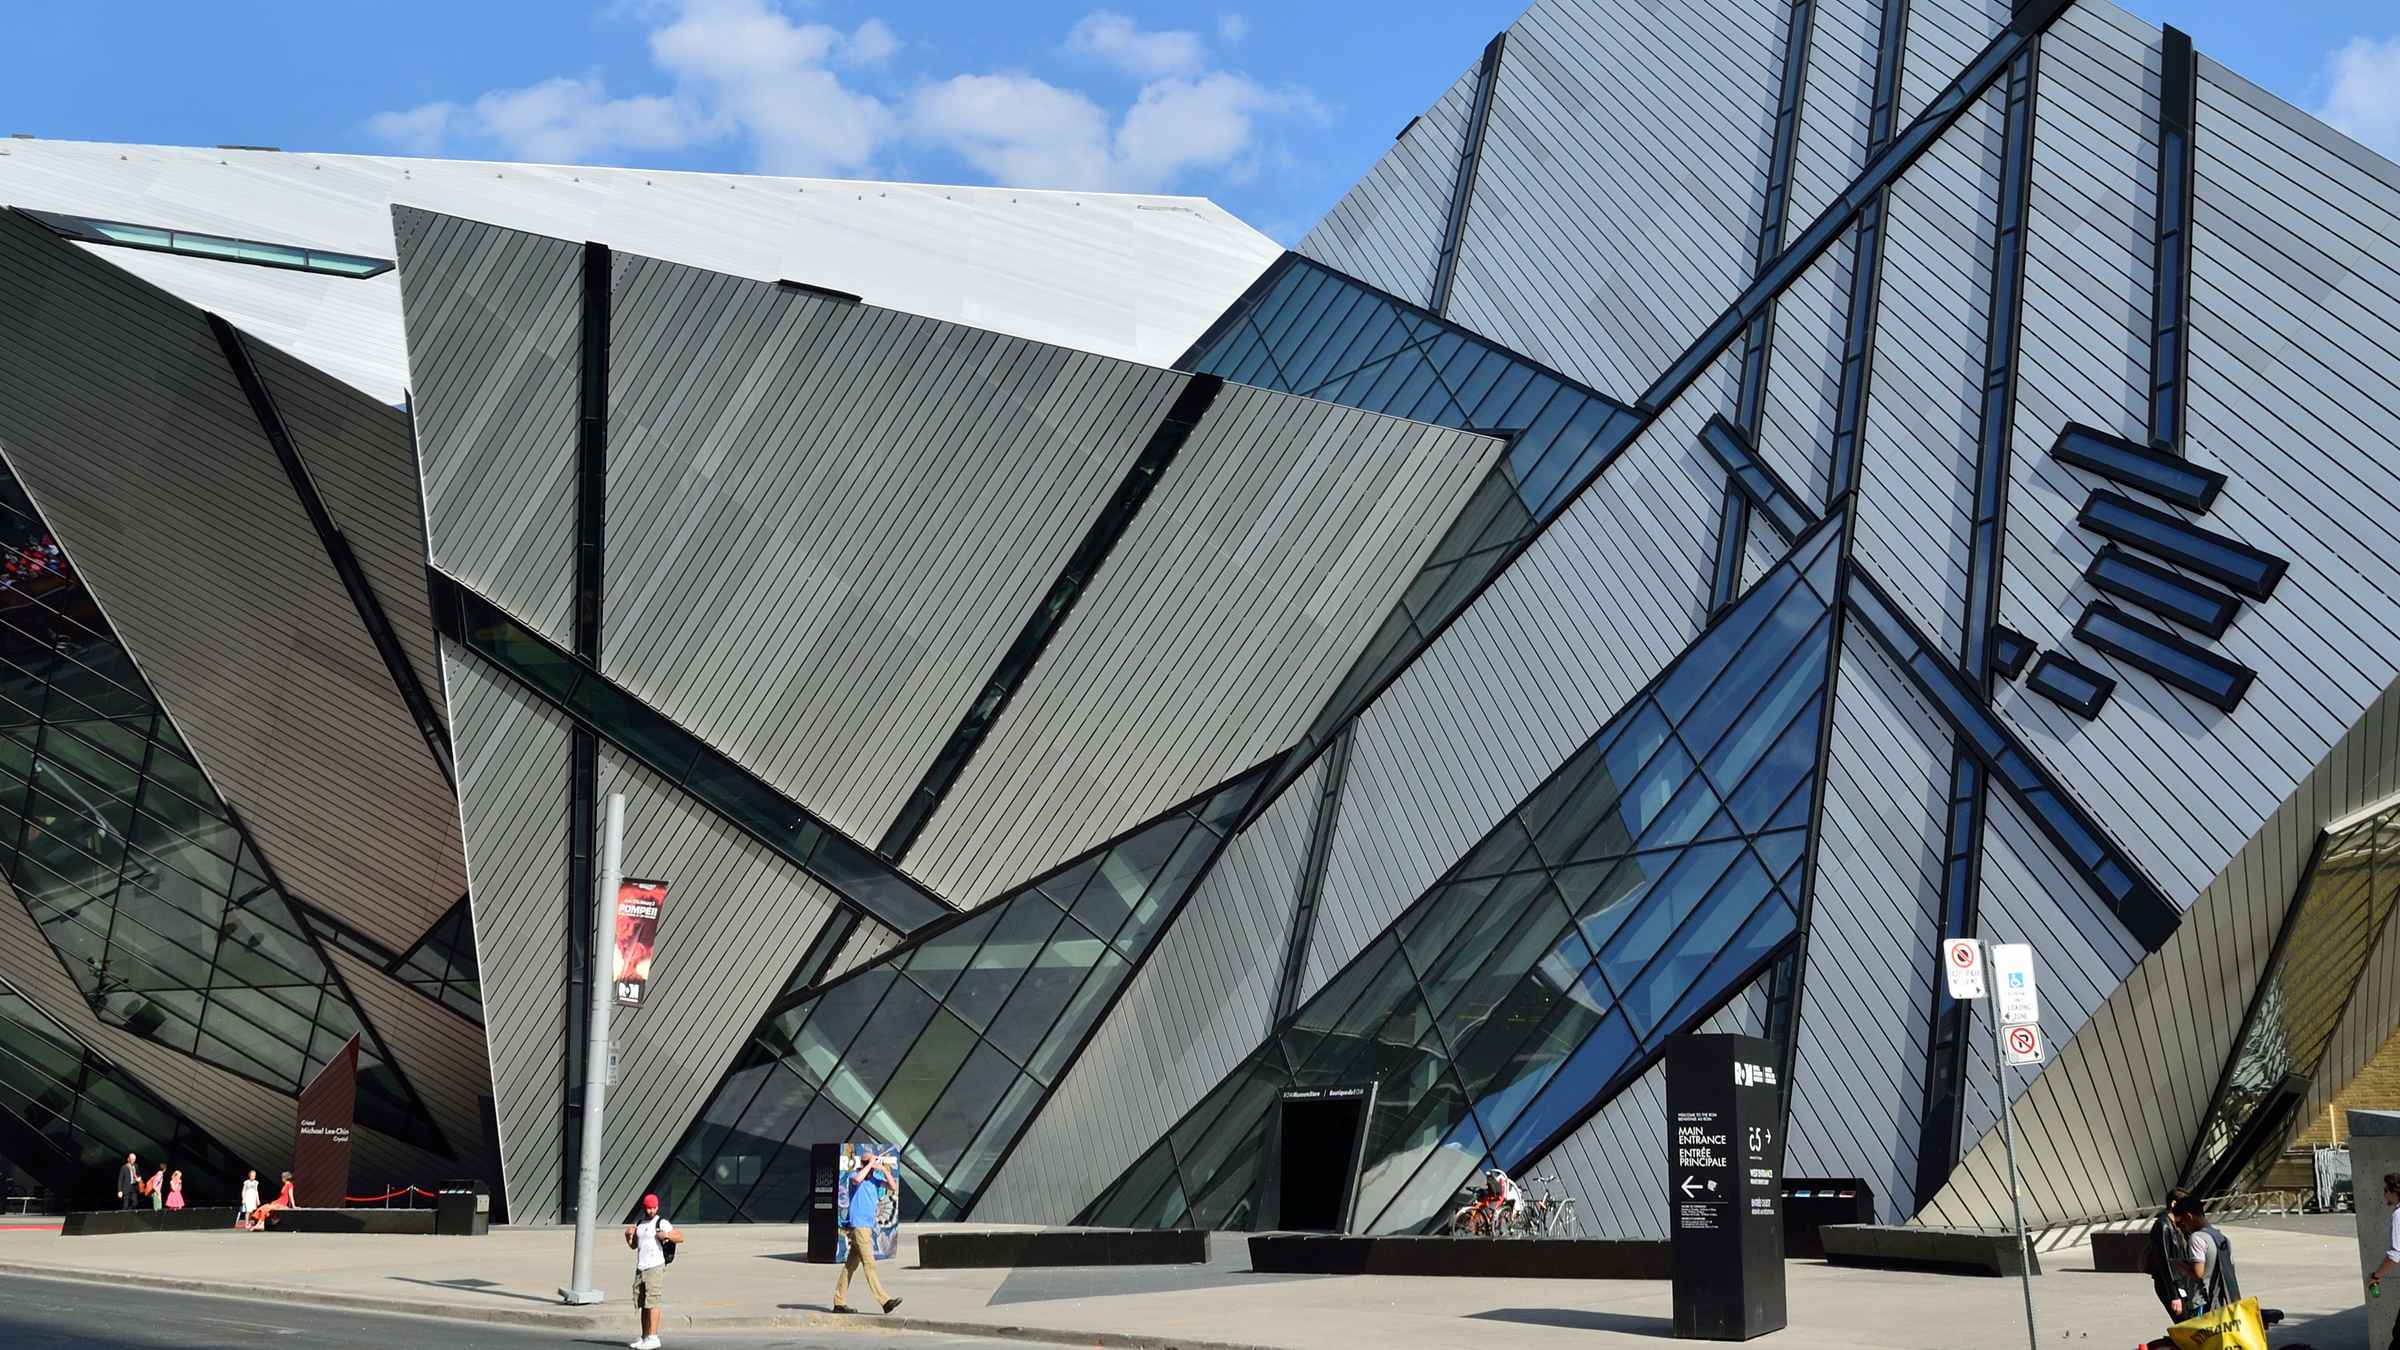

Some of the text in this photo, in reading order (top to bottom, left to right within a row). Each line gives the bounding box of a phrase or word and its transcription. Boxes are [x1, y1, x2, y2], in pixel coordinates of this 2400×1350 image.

[618, 903, 658, 916] POMPEII
[1678, 1126, 1704, 1136] MAIN
[1679, 1135, 1727, 1145] ENTRANCE
[1679, 1146, 1711, 1158] ENTRÉE
[1679, 1157, 1727, 1167] PRINCIPALE
